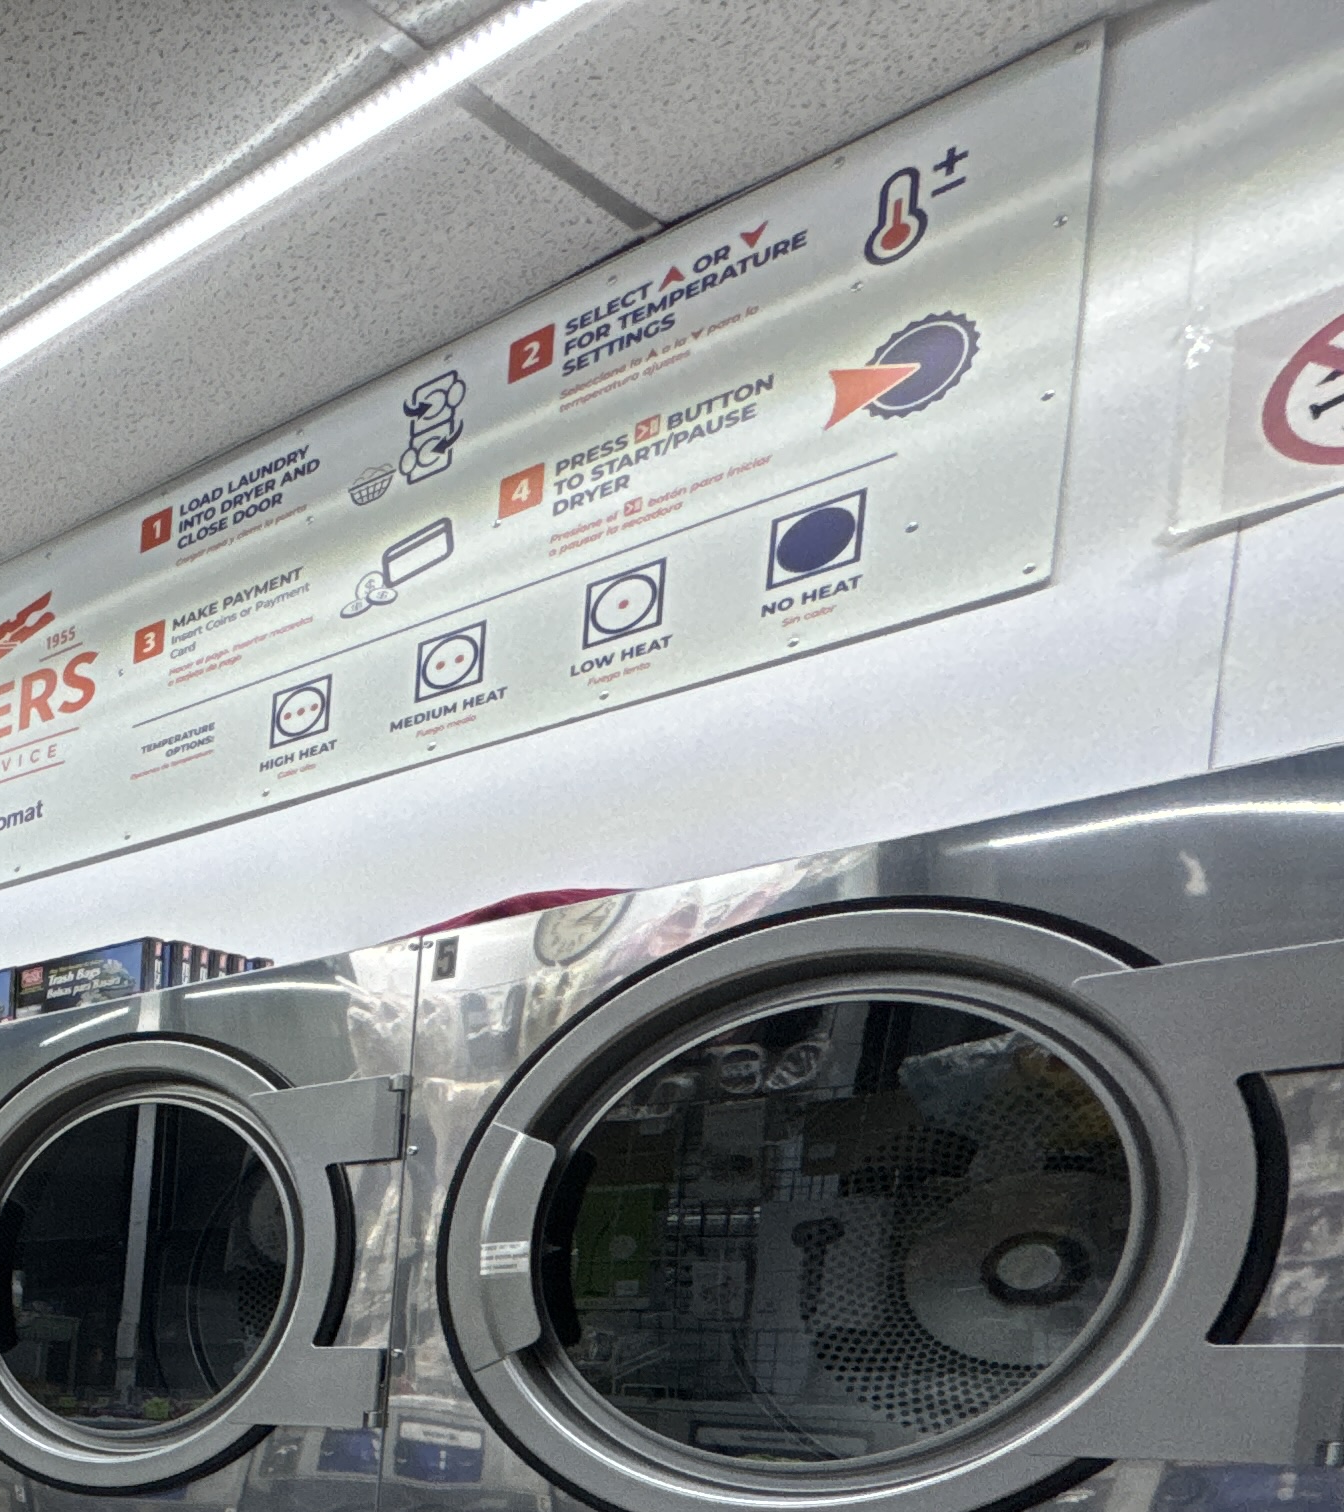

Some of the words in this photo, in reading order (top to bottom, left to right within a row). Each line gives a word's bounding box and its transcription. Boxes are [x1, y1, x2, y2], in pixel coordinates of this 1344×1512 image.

[563, 323, 611, 356] FOR
[617, 228, 809, 331] TEMPERATURE
[565, 280, 654, 337] SELECT
[692, 245, 732, 274] OR
[520, 341, 541, 370] 2
[559, 363, 626, 401] Seleccione
[706, 312, 741, 337] para
[562, 313, 676, 378] SETTINGS
[555, 433, 629, 477] PRESS
[666, 373, 775, 431] BUTTON
[552, 472, 585, 495] TO
[590, 402, 758, 483] START/PAUSE
[179, 508, 215, 533] INTO
[221, 478, 275, 515] DRYER
[280, 458, 320, 487] AND
[180, 486, 223, 517] LOAD
[228, 444, 309, 494] LAUNDRY
[511, 477, 532, 503] 4
[552, 473, 631, 517] DRYER
[177, 521, 228, 550] CLOSE
[232, 492, 283, 525] DOOR
[549, 517, 604, 545] Presione
[689, 469, 724, 495] para
[152, 520, 161, 539] 1
[171, 626, 202, 645] Insert
[205, 612, 237, 631] Coins
[240, 606, 252, 618] or
[255, 582, 310, 612] Payment
[172, 601, 218, 631] MAKE
[223, 566, 304, 610] PAYMENT
[760, 596, 794, 618] NO
[802, 574, 864, 605] HEAT
[46, 626, 76, 650] 1955
[143, 631, 156, 653] 3
[781, 612, 800, 629] Sin
[170, 641, 196, 659] Card
[569, 651, 616, 678] LOW
[620, 635, 673, 662] HEAT
[389, 702, 457, 733] MEDIUM
[462, 686, 508, 711] HEAT
[141, 722, 215, 755] TEMPERATURE
[259, 752, 295, 773] HIGH
[299, 739, 338, 761] HEAT
[49, 973, 74, 986] Trash
[76, 968, 101, 980] Bags
[437, 940, 456, 977] 5
